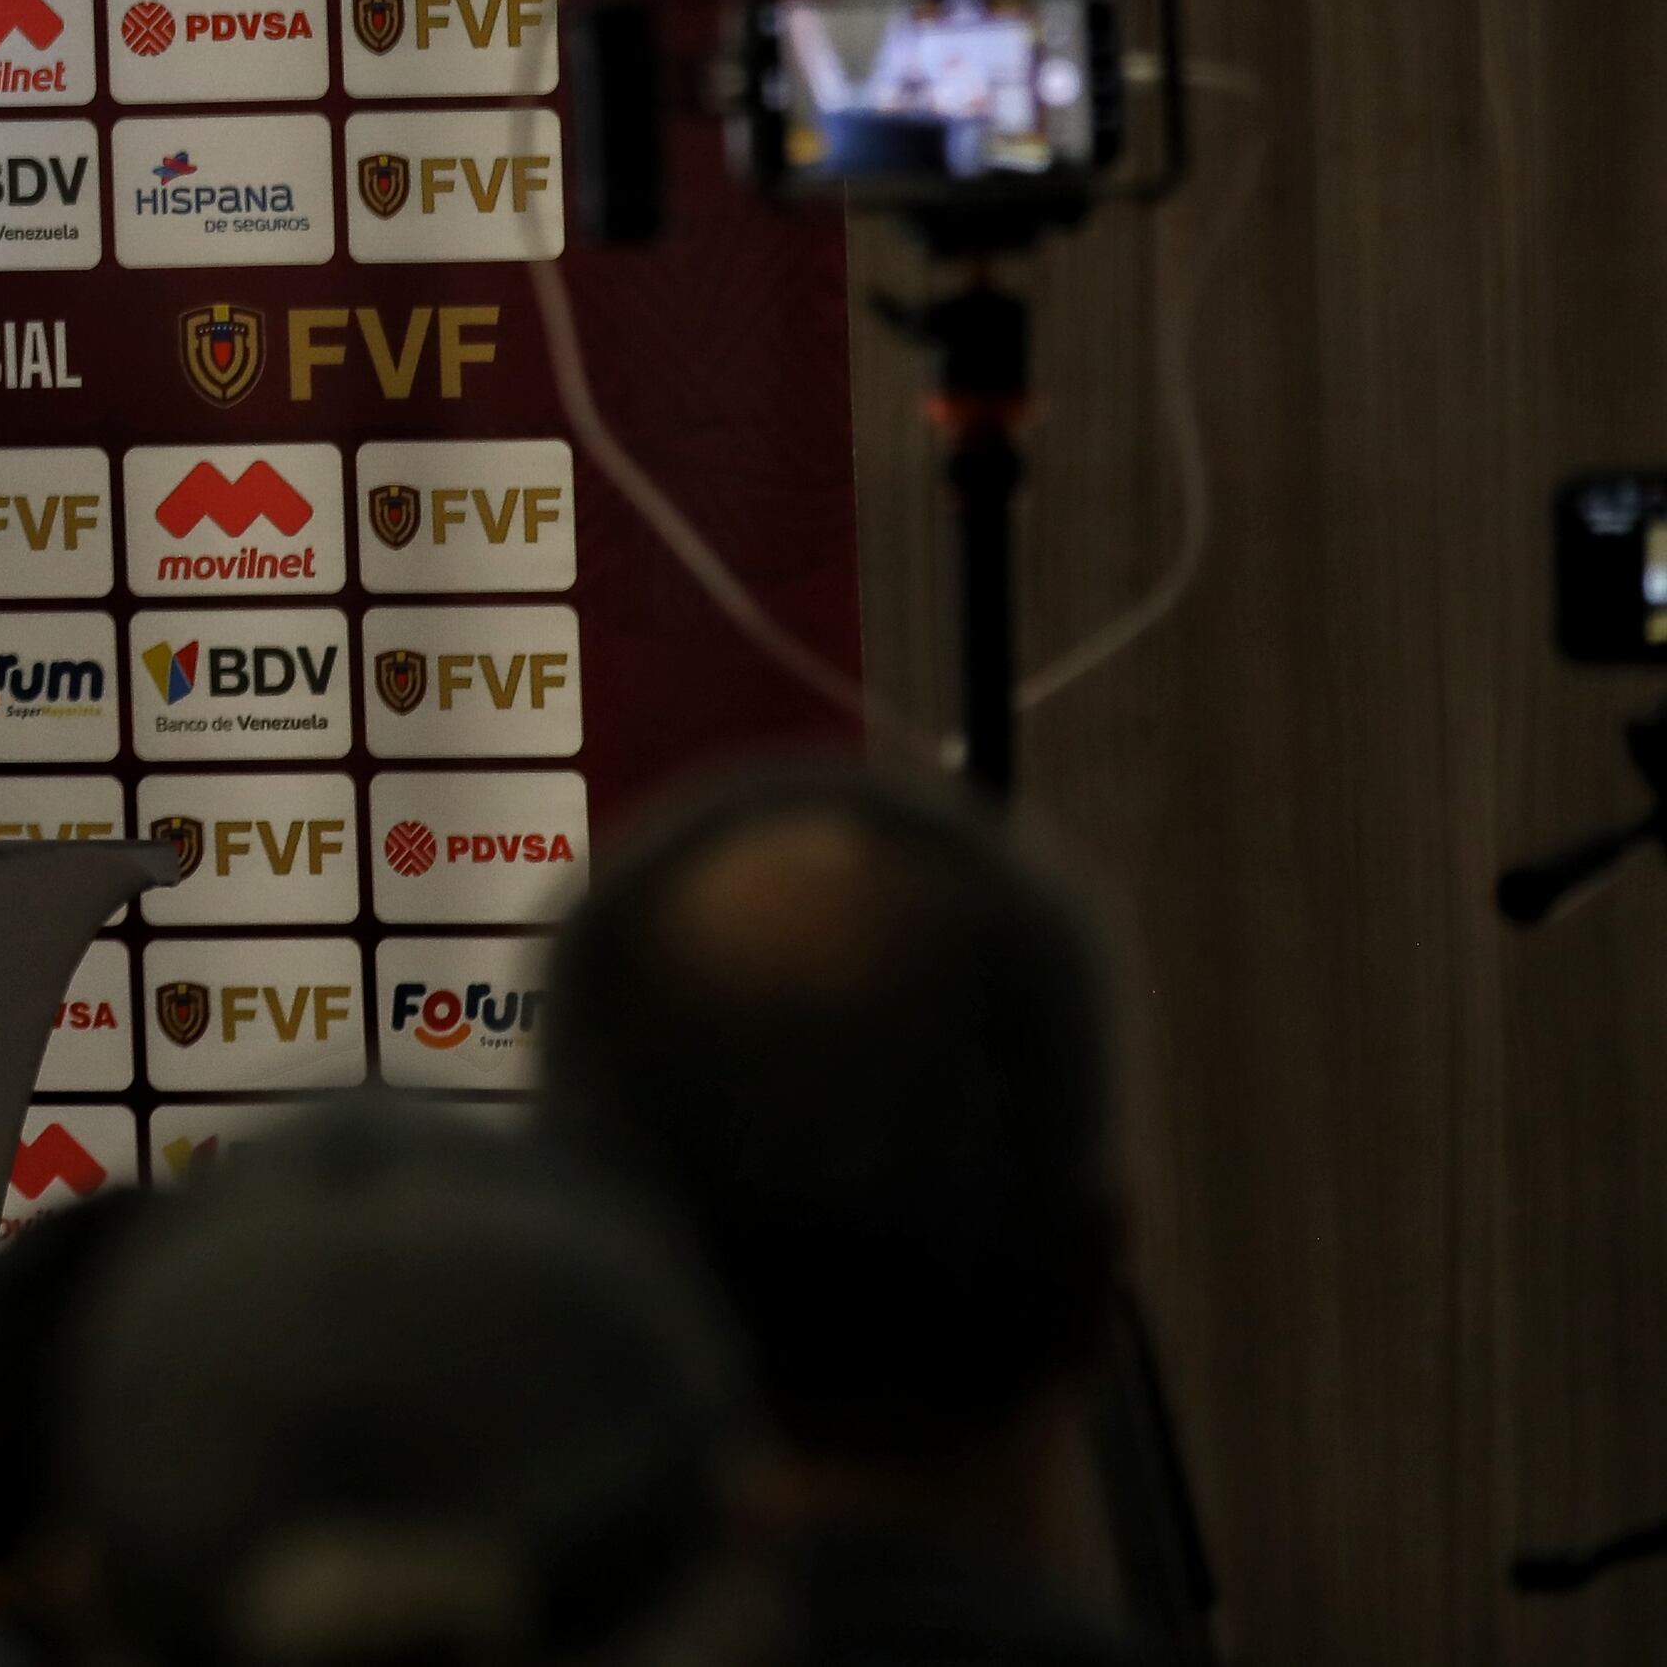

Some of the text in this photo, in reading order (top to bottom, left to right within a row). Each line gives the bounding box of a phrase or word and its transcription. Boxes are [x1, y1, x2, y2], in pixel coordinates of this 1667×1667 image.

[186, 11, 312, 41] PDVSA
[419, 151, 550, 214] FVF
[288, 305, 500, 400] FVF
[431, 487, 561, 547] FVF
[157, 547, 316, 581] movilnet
[209, 646, 338, 697] BDV
[438, 653, 568, 712] FVF
[155, 713, 330, 734] Banco de Venezuela
[214, 819, 345, 877] FVF
[446, 834, 574, 865] PDVSA
[220, 986, 351, 1043] FVF
